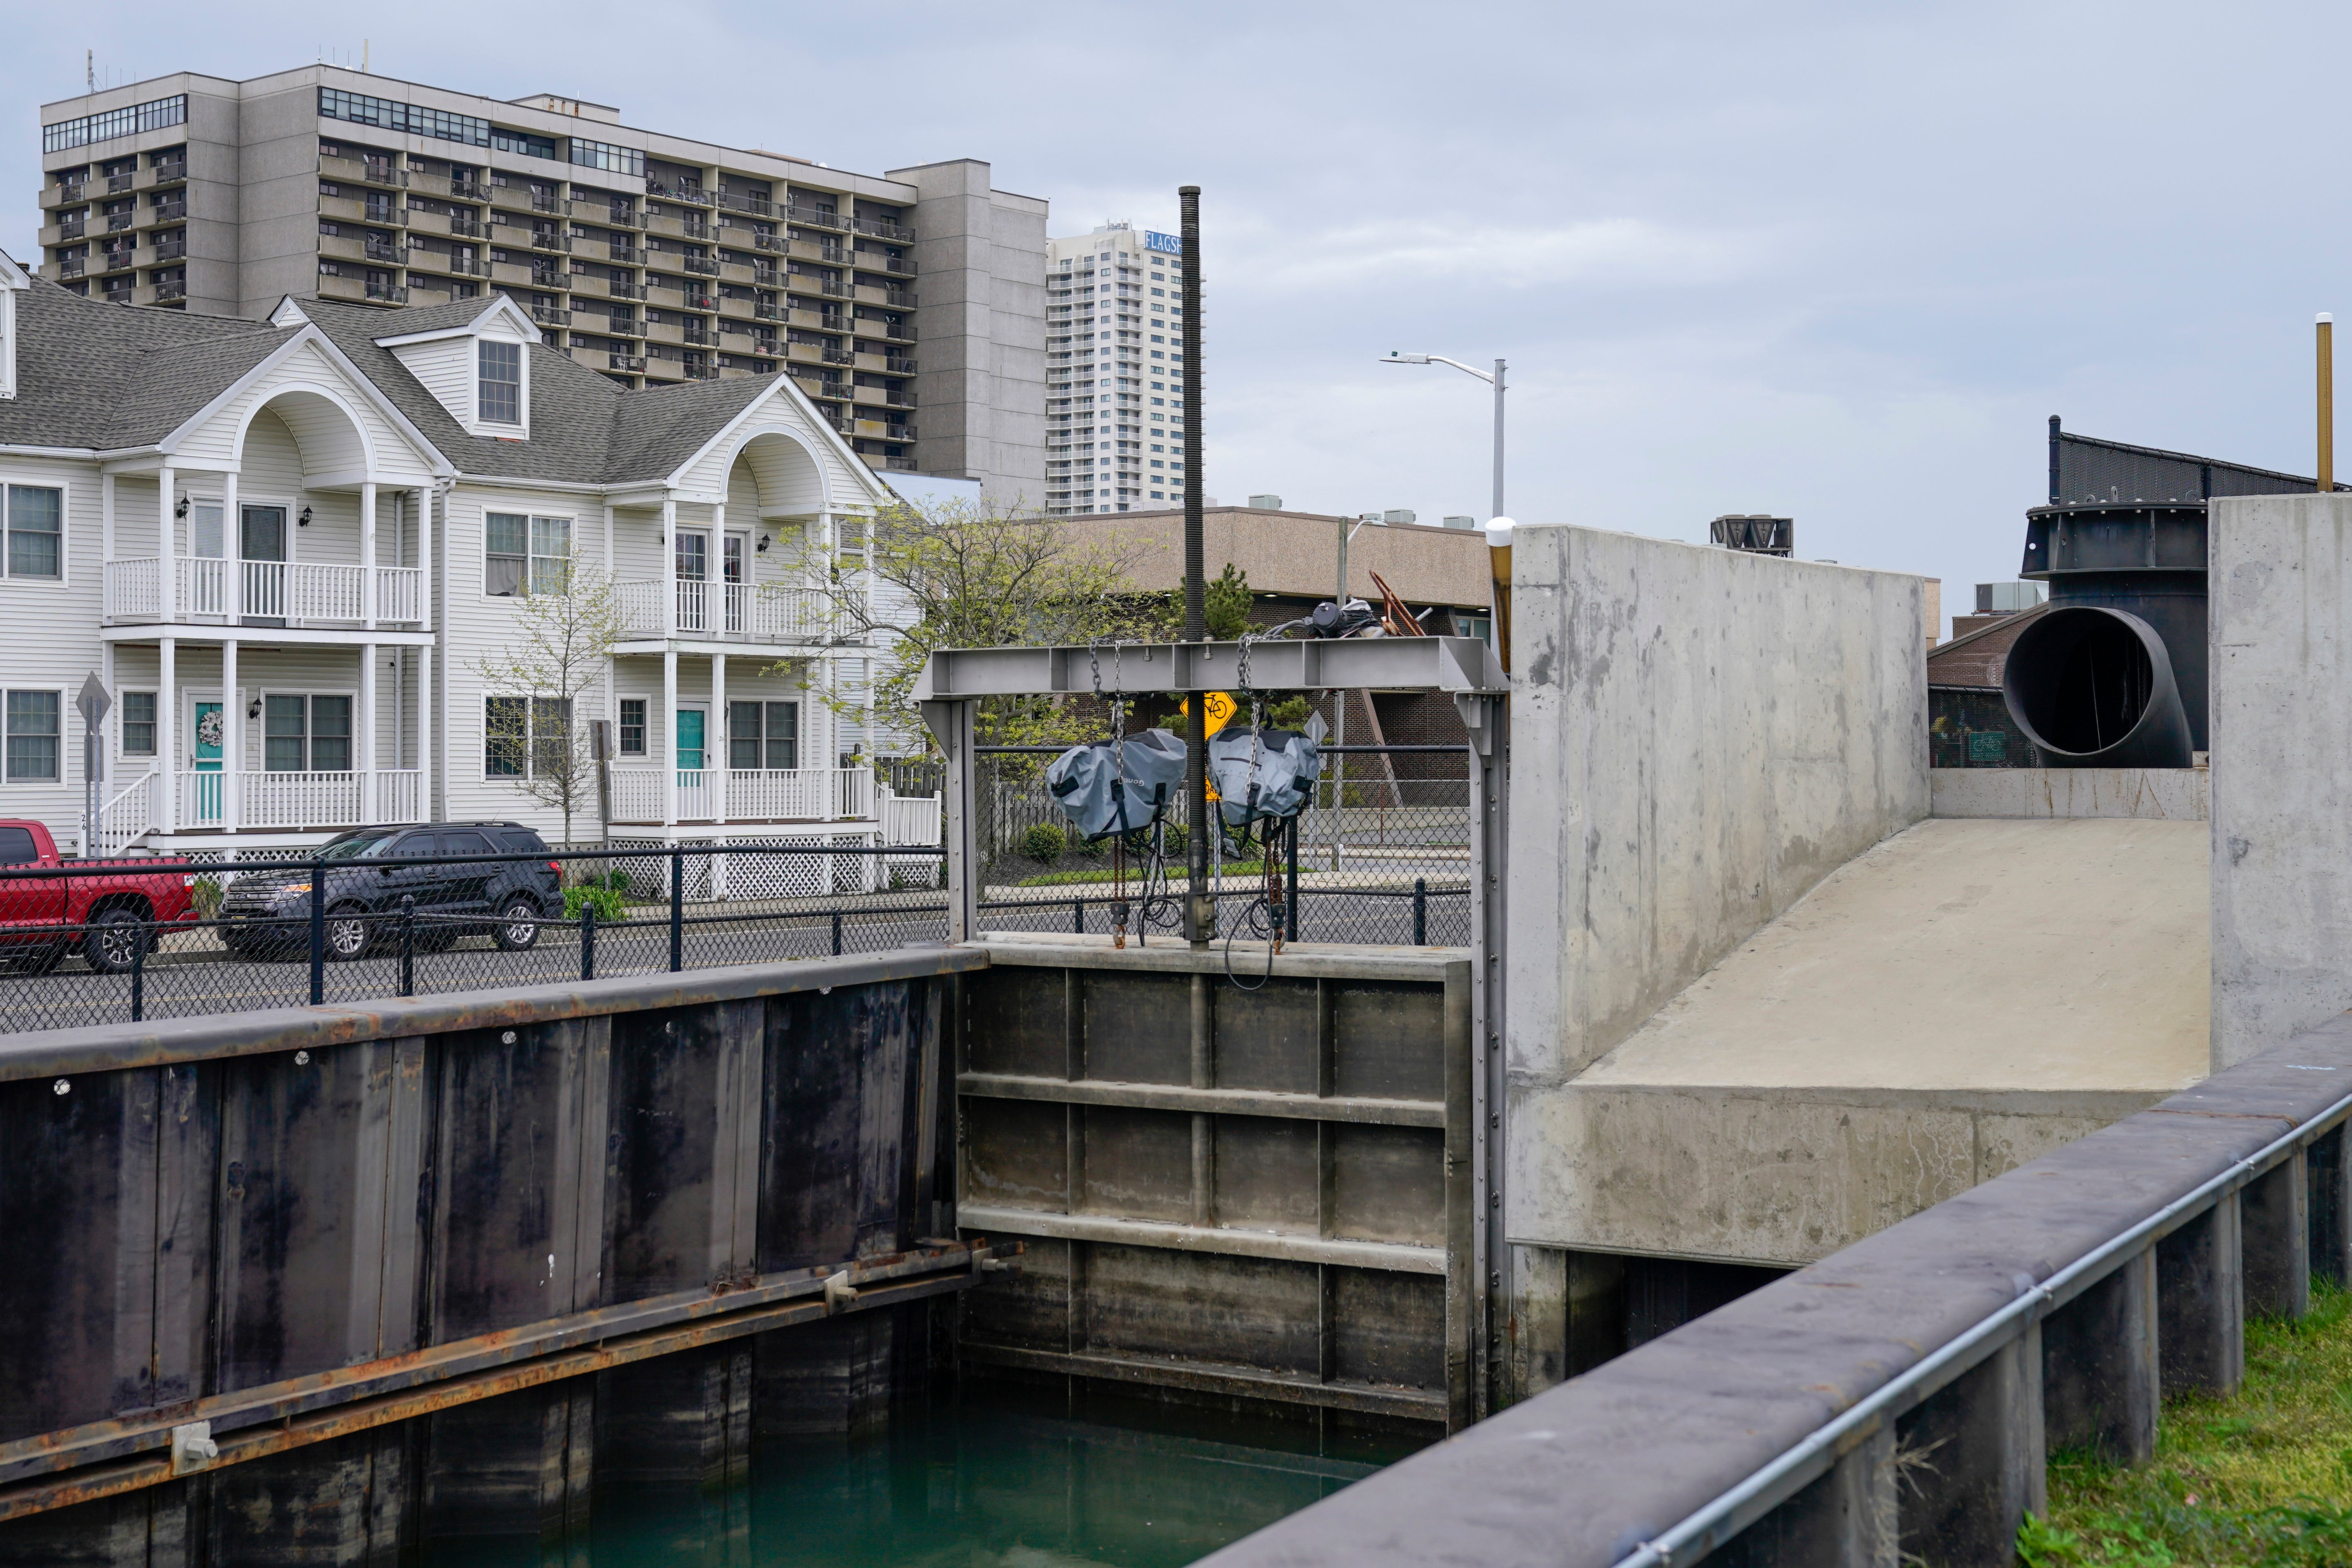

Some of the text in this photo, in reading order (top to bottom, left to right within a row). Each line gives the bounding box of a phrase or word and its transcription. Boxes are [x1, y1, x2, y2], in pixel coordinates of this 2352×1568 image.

[1146, 232, 1182, 253] FLAGSH
[1123, 778, 1145, 787] Gone
[81, 814, 86, 830] 26
